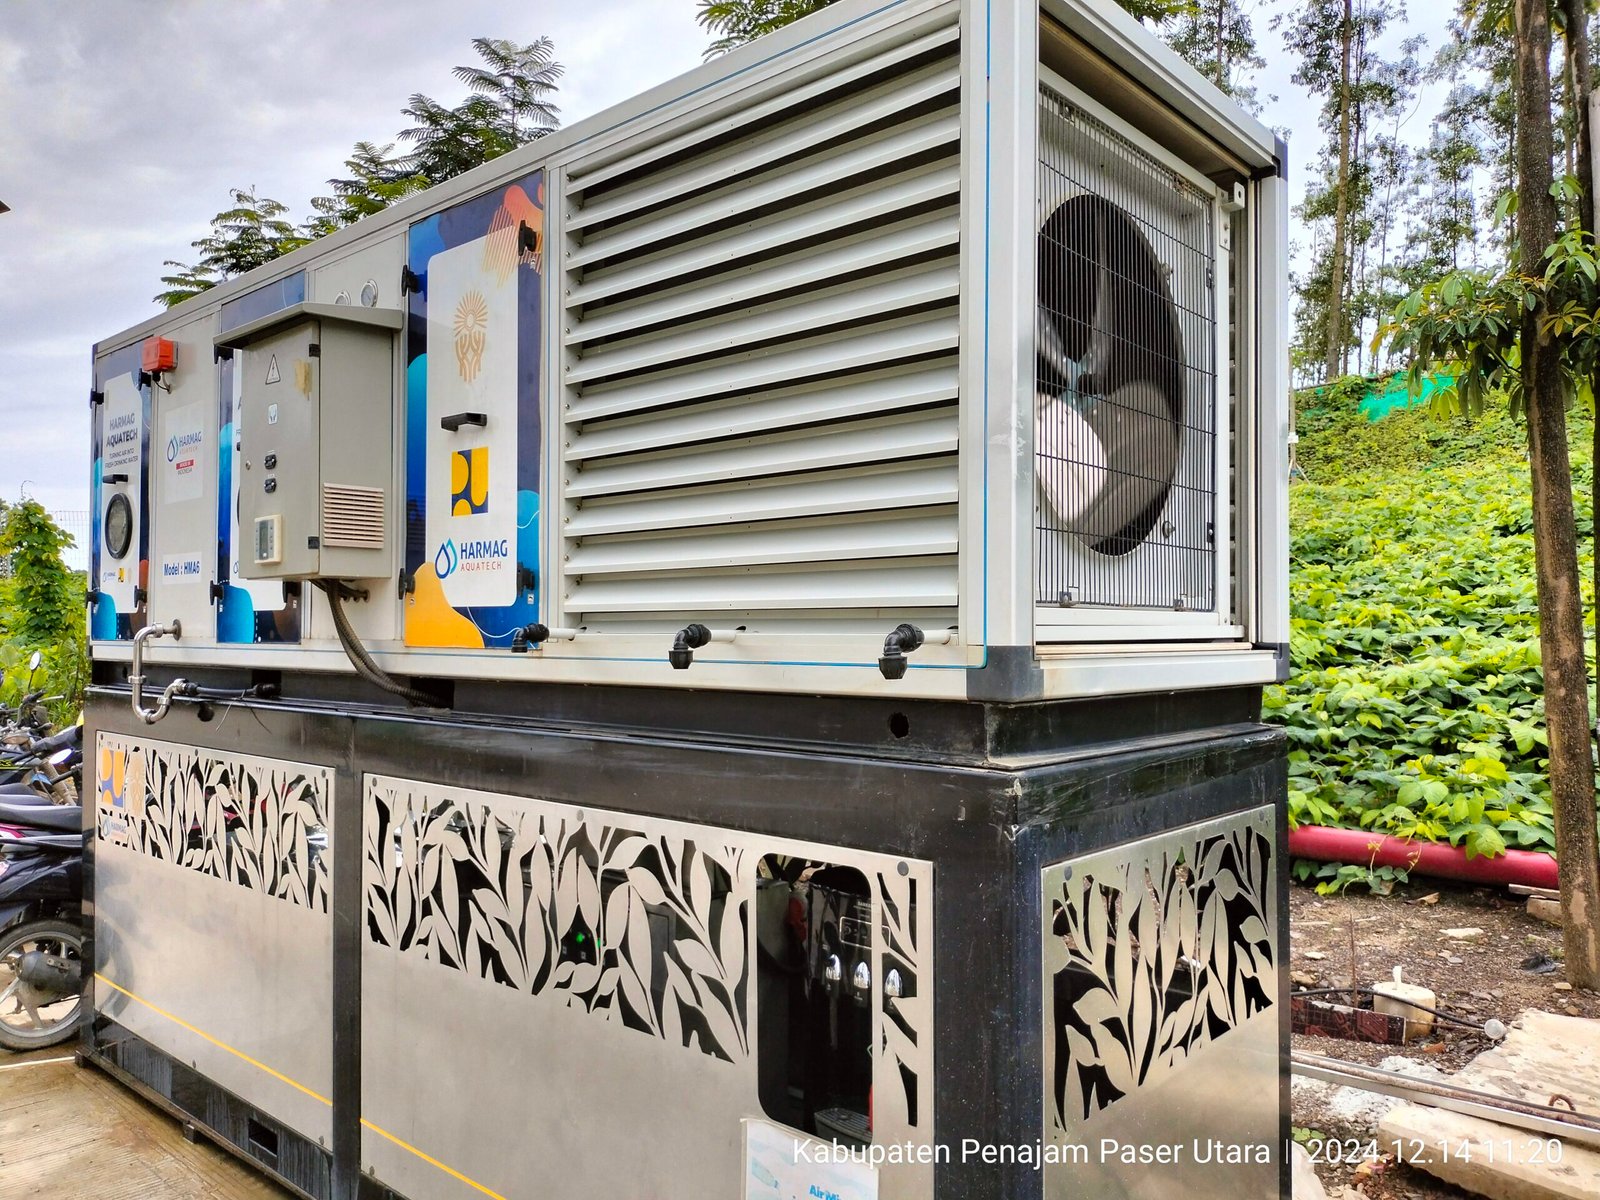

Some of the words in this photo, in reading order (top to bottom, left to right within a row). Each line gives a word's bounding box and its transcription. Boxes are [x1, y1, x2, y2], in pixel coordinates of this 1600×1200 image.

[110, 413, 135, 431] HARMAG
[106, 429, 138, 447] AQUATECH
[179, 431, 202, 447] HARMAG
[460, 539, 508, 560] HARMAG
[164, 562, 180, 576] Model
[184, 560, 200, 575] HMA6
[460, 561, 502, 572] AQUATECH
[809, 1184, 825, 1199] Air
